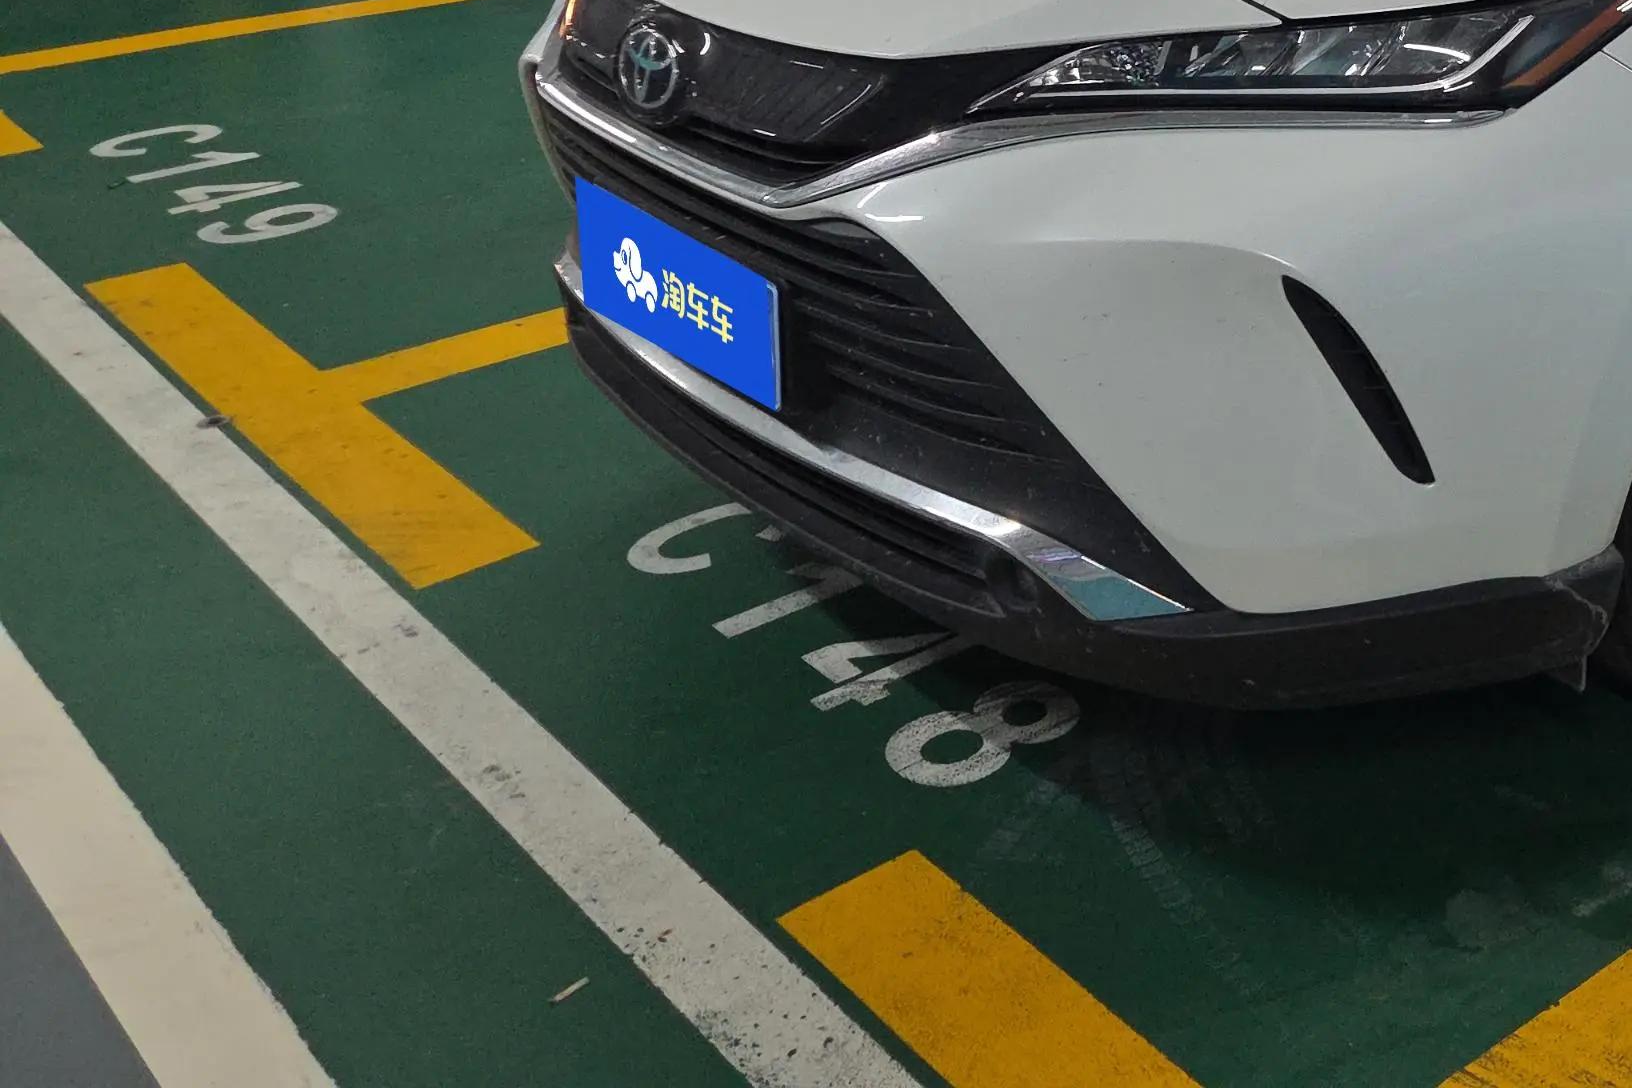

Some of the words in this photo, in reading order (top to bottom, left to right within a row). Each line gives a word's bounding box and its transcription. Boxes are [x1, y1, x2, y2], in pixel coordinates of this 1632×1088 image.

[89, 124, 339, 244] C149
[661, 268, 734, 344] 淘车车
[627, 502, 1081, 788] C148
